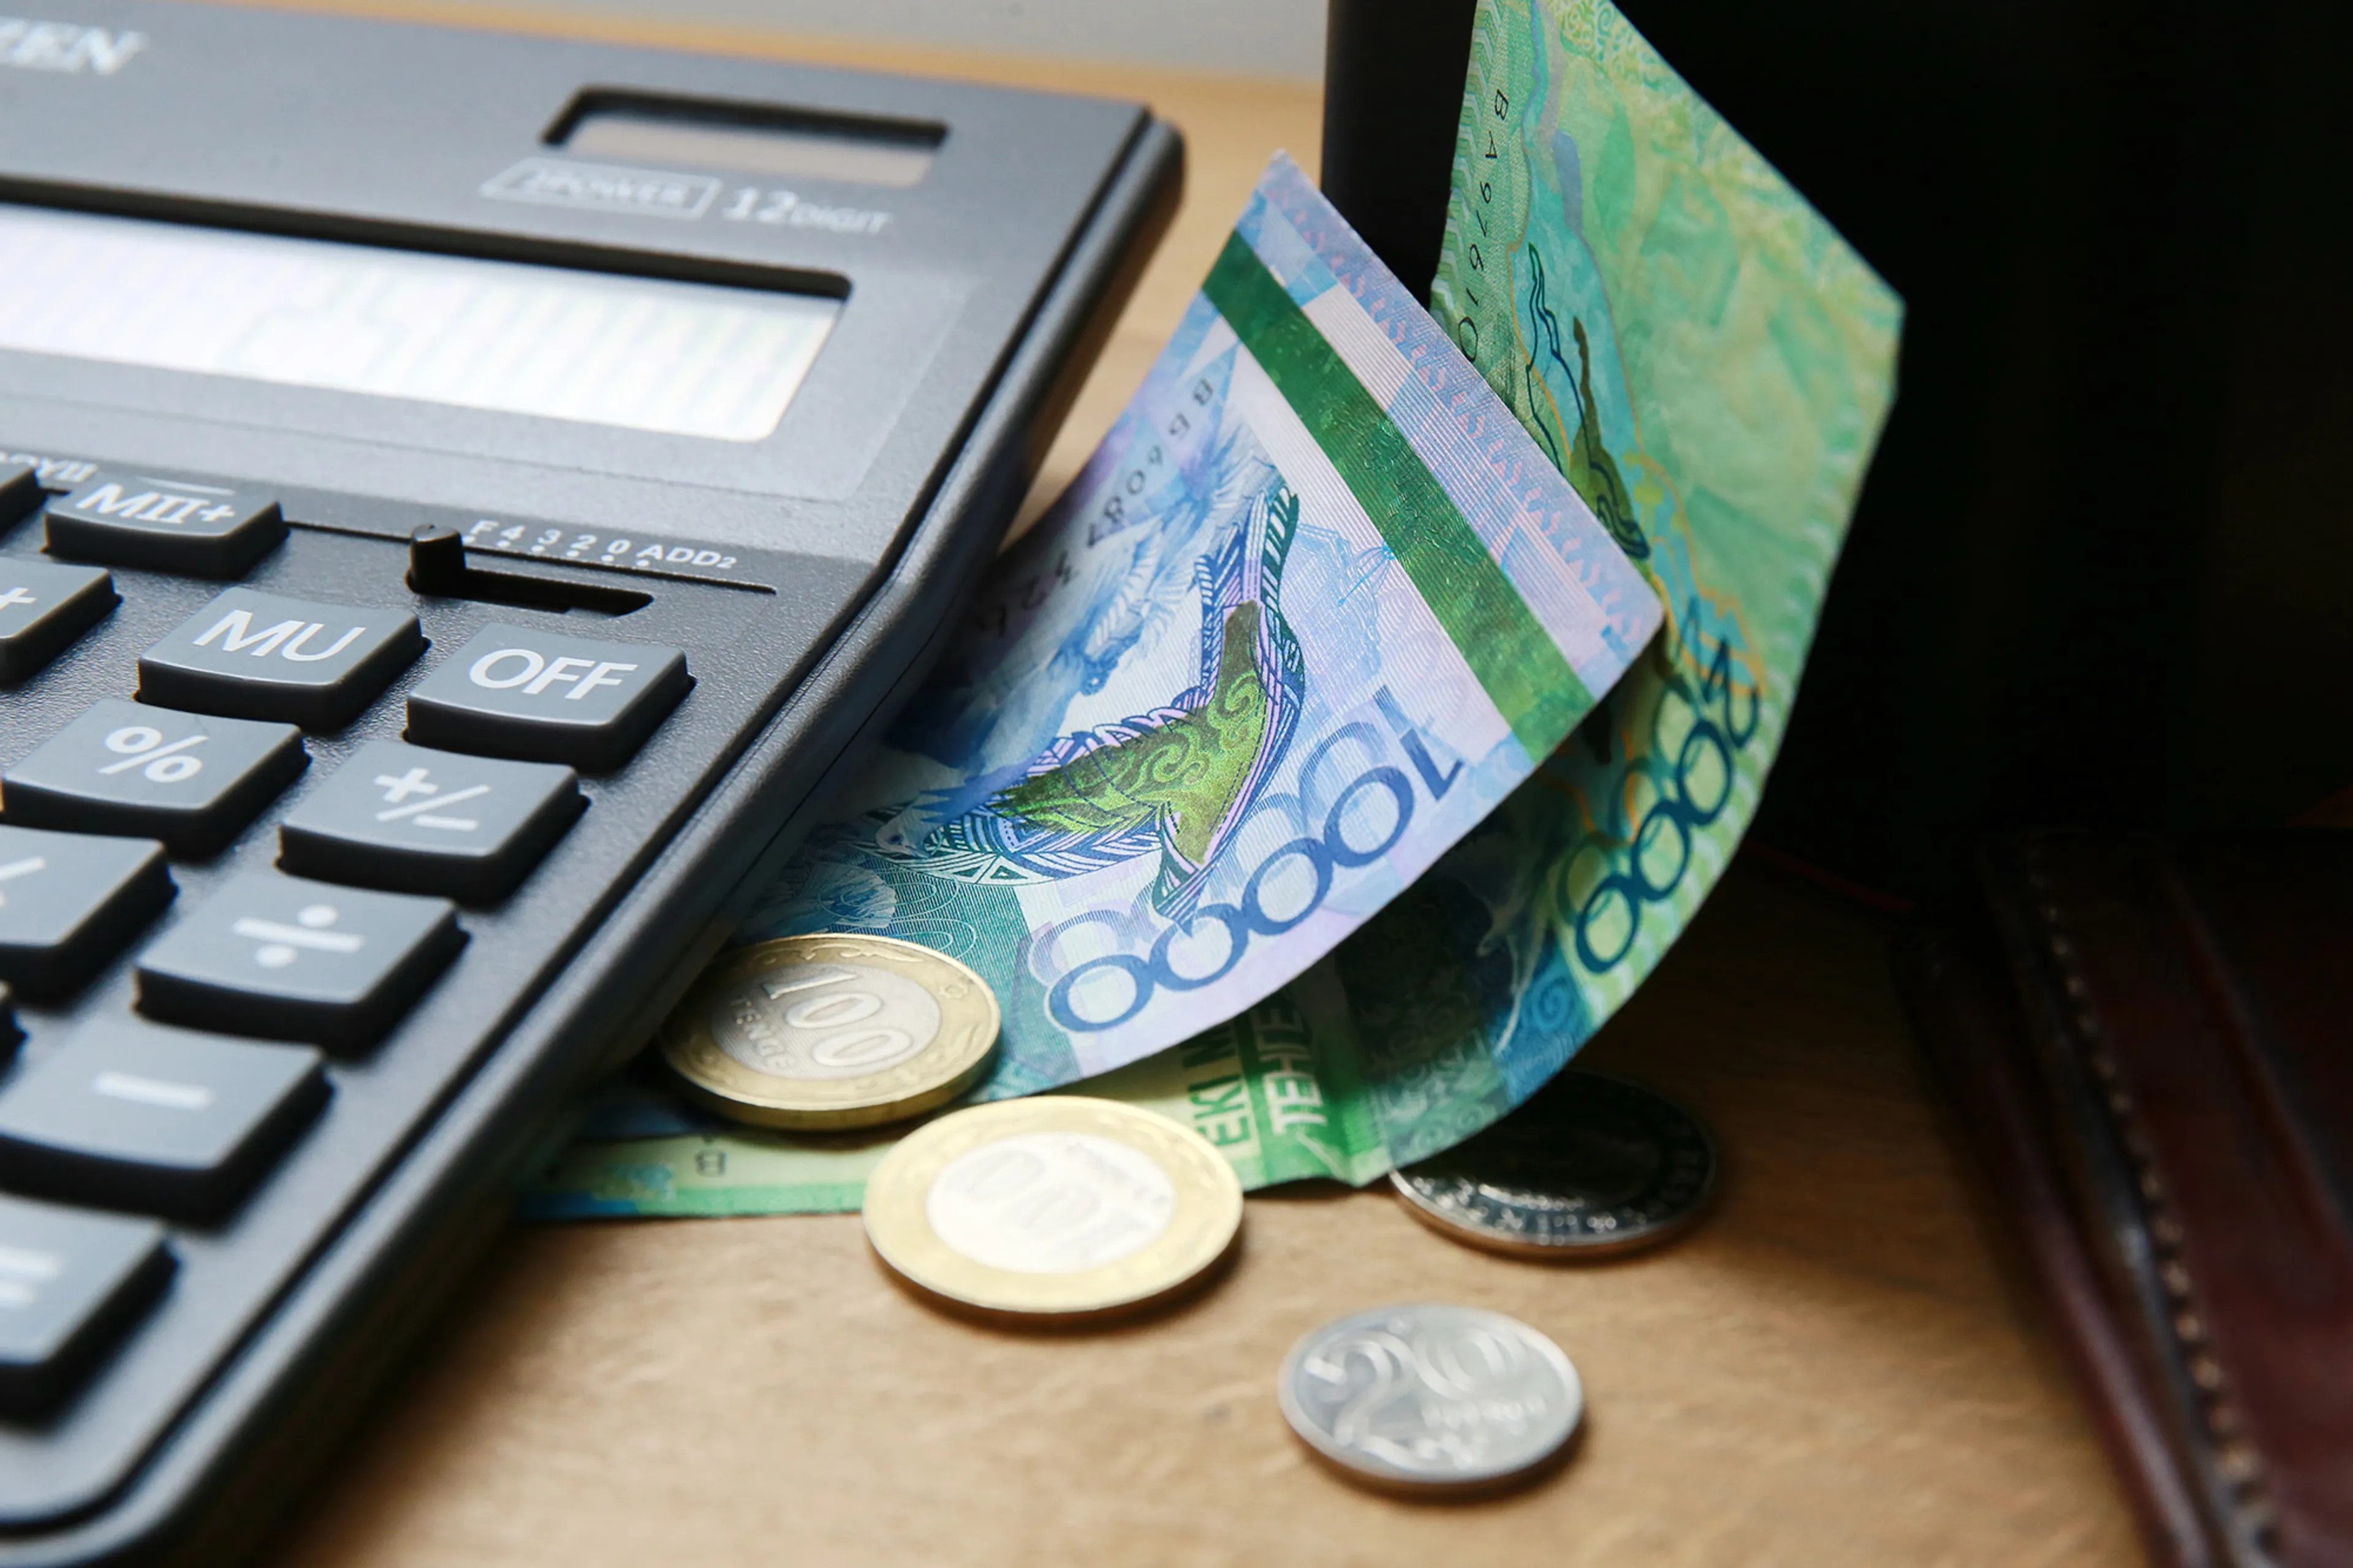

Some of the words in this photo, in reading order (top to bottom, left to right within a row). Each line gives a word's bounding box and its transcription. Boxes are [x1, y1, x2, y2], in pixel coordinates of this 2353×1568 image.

[469, 520, 499, 537] F
[499, 526, 526, 540] 4
[537, 529, 563, 547] 3
[569, 535, 598, 551] 2
[606, 540, 632, 555] 0
[191, 608, 366, 662] MU
[469, 648, 638, 701] OFF
[98, 726, 208, 783] %
[1575, 637, 1761, 975] 2000
[1048, 728, 1466, 1033] 10000
[760, 967, 913, 1067] 100
[1303, 1325, 1528, 1469] 20
